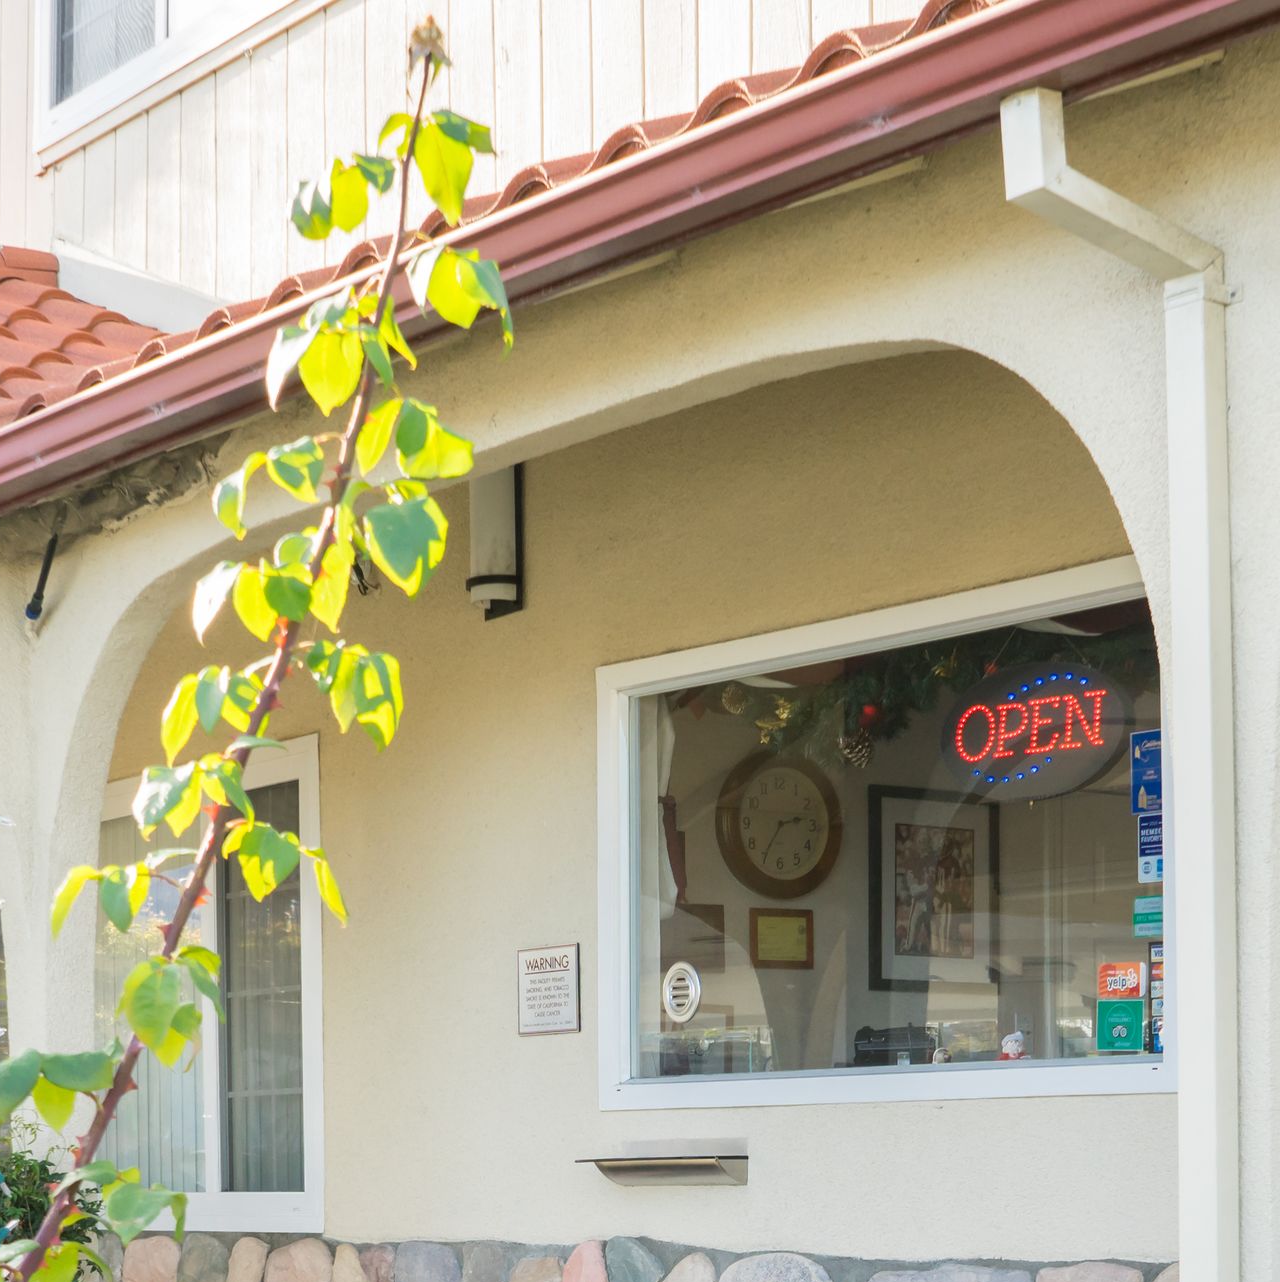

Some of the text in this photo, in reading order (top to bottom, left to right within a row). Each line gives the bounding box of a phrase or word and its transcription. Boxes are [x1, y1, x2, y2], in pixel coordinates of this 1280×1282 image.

[954, 688, 1108, 764] OPEN
[761, 783, 768, 796] 11
[775, 778, 785, 791] 12
[794, 785, 799, 796] 1
[749, 797, 759, 810] 10
[804, 799, 813, 810] 2
[743, 817, 751, 830] 9
[809, 820, 817, 833] 3
[749, 838, 756, 850] 8
[804, 840, 811, 851] 4
[777, 858, 784, 870] 6
[793, 853, 801, 866] 5
[525, 955, 569, 971] WARNING
[1107, 974, 1127, 990] yelp
